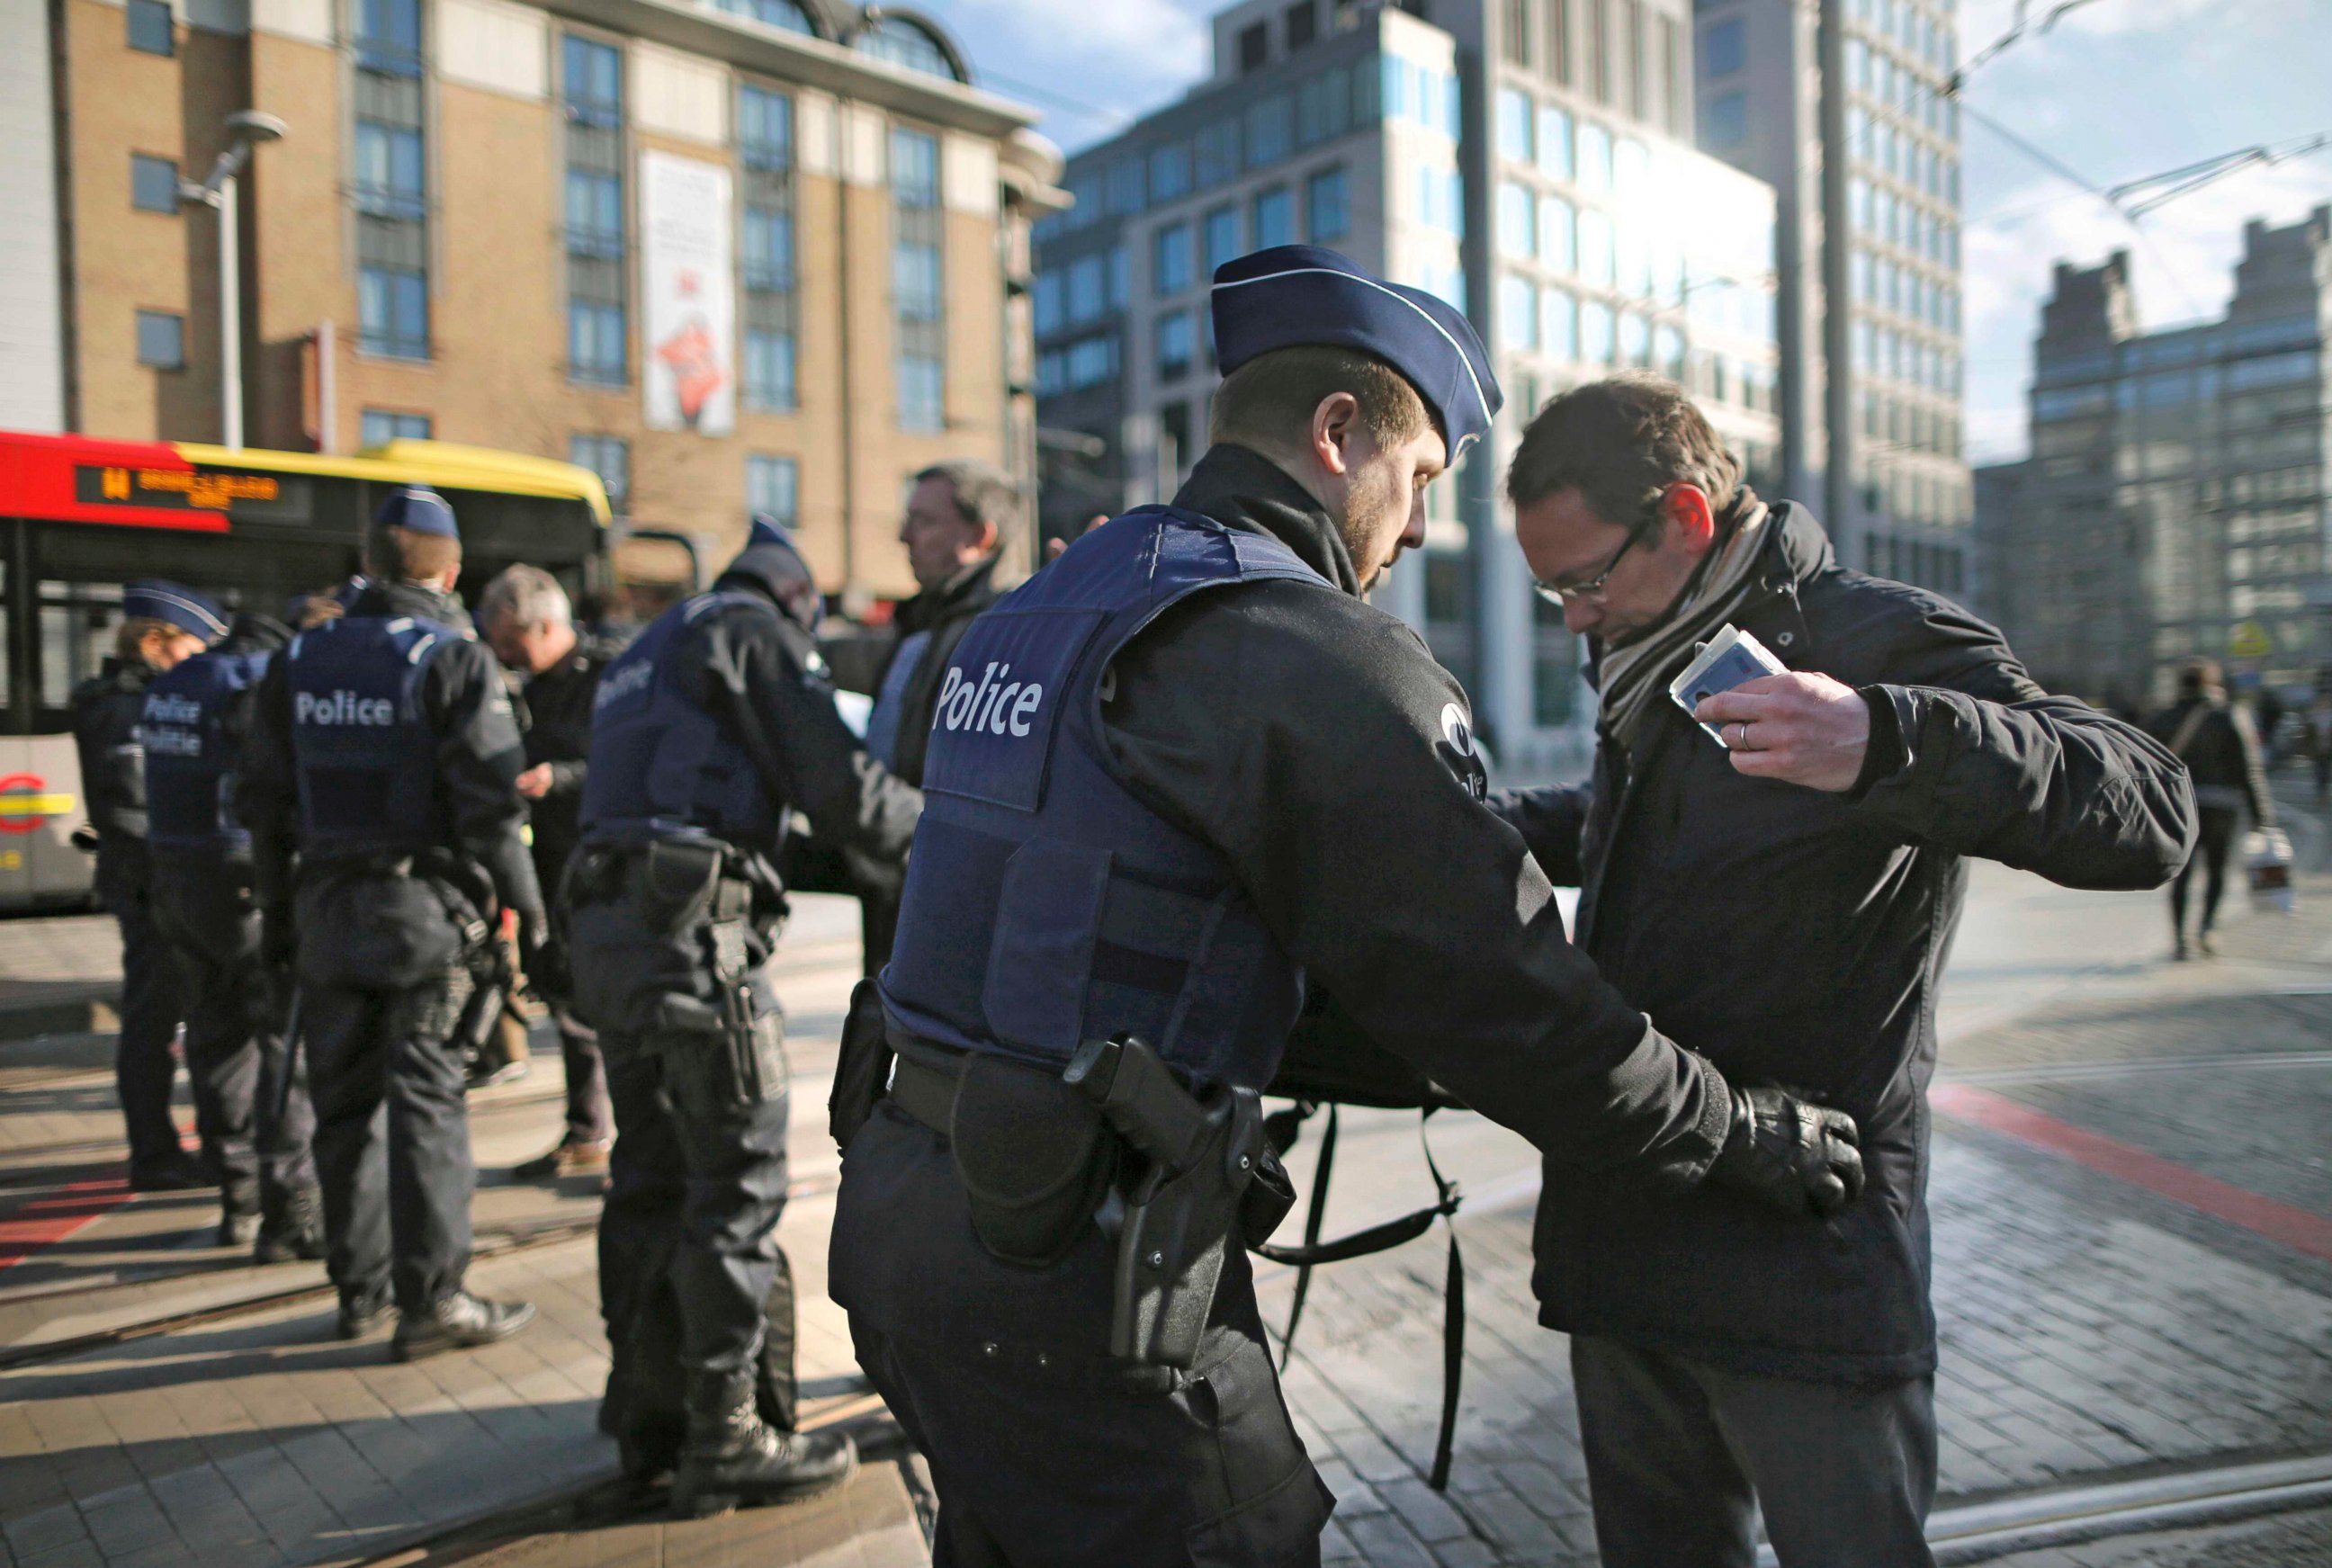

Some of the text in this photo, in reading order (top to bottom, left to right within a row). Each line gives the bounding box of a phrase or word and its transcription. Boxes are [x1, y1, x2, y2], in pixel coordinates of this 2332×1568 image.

[145, 692, 201, 724] Police
[295, 689, 393, 726] Police
[932, 661, 1043, 737] Police
